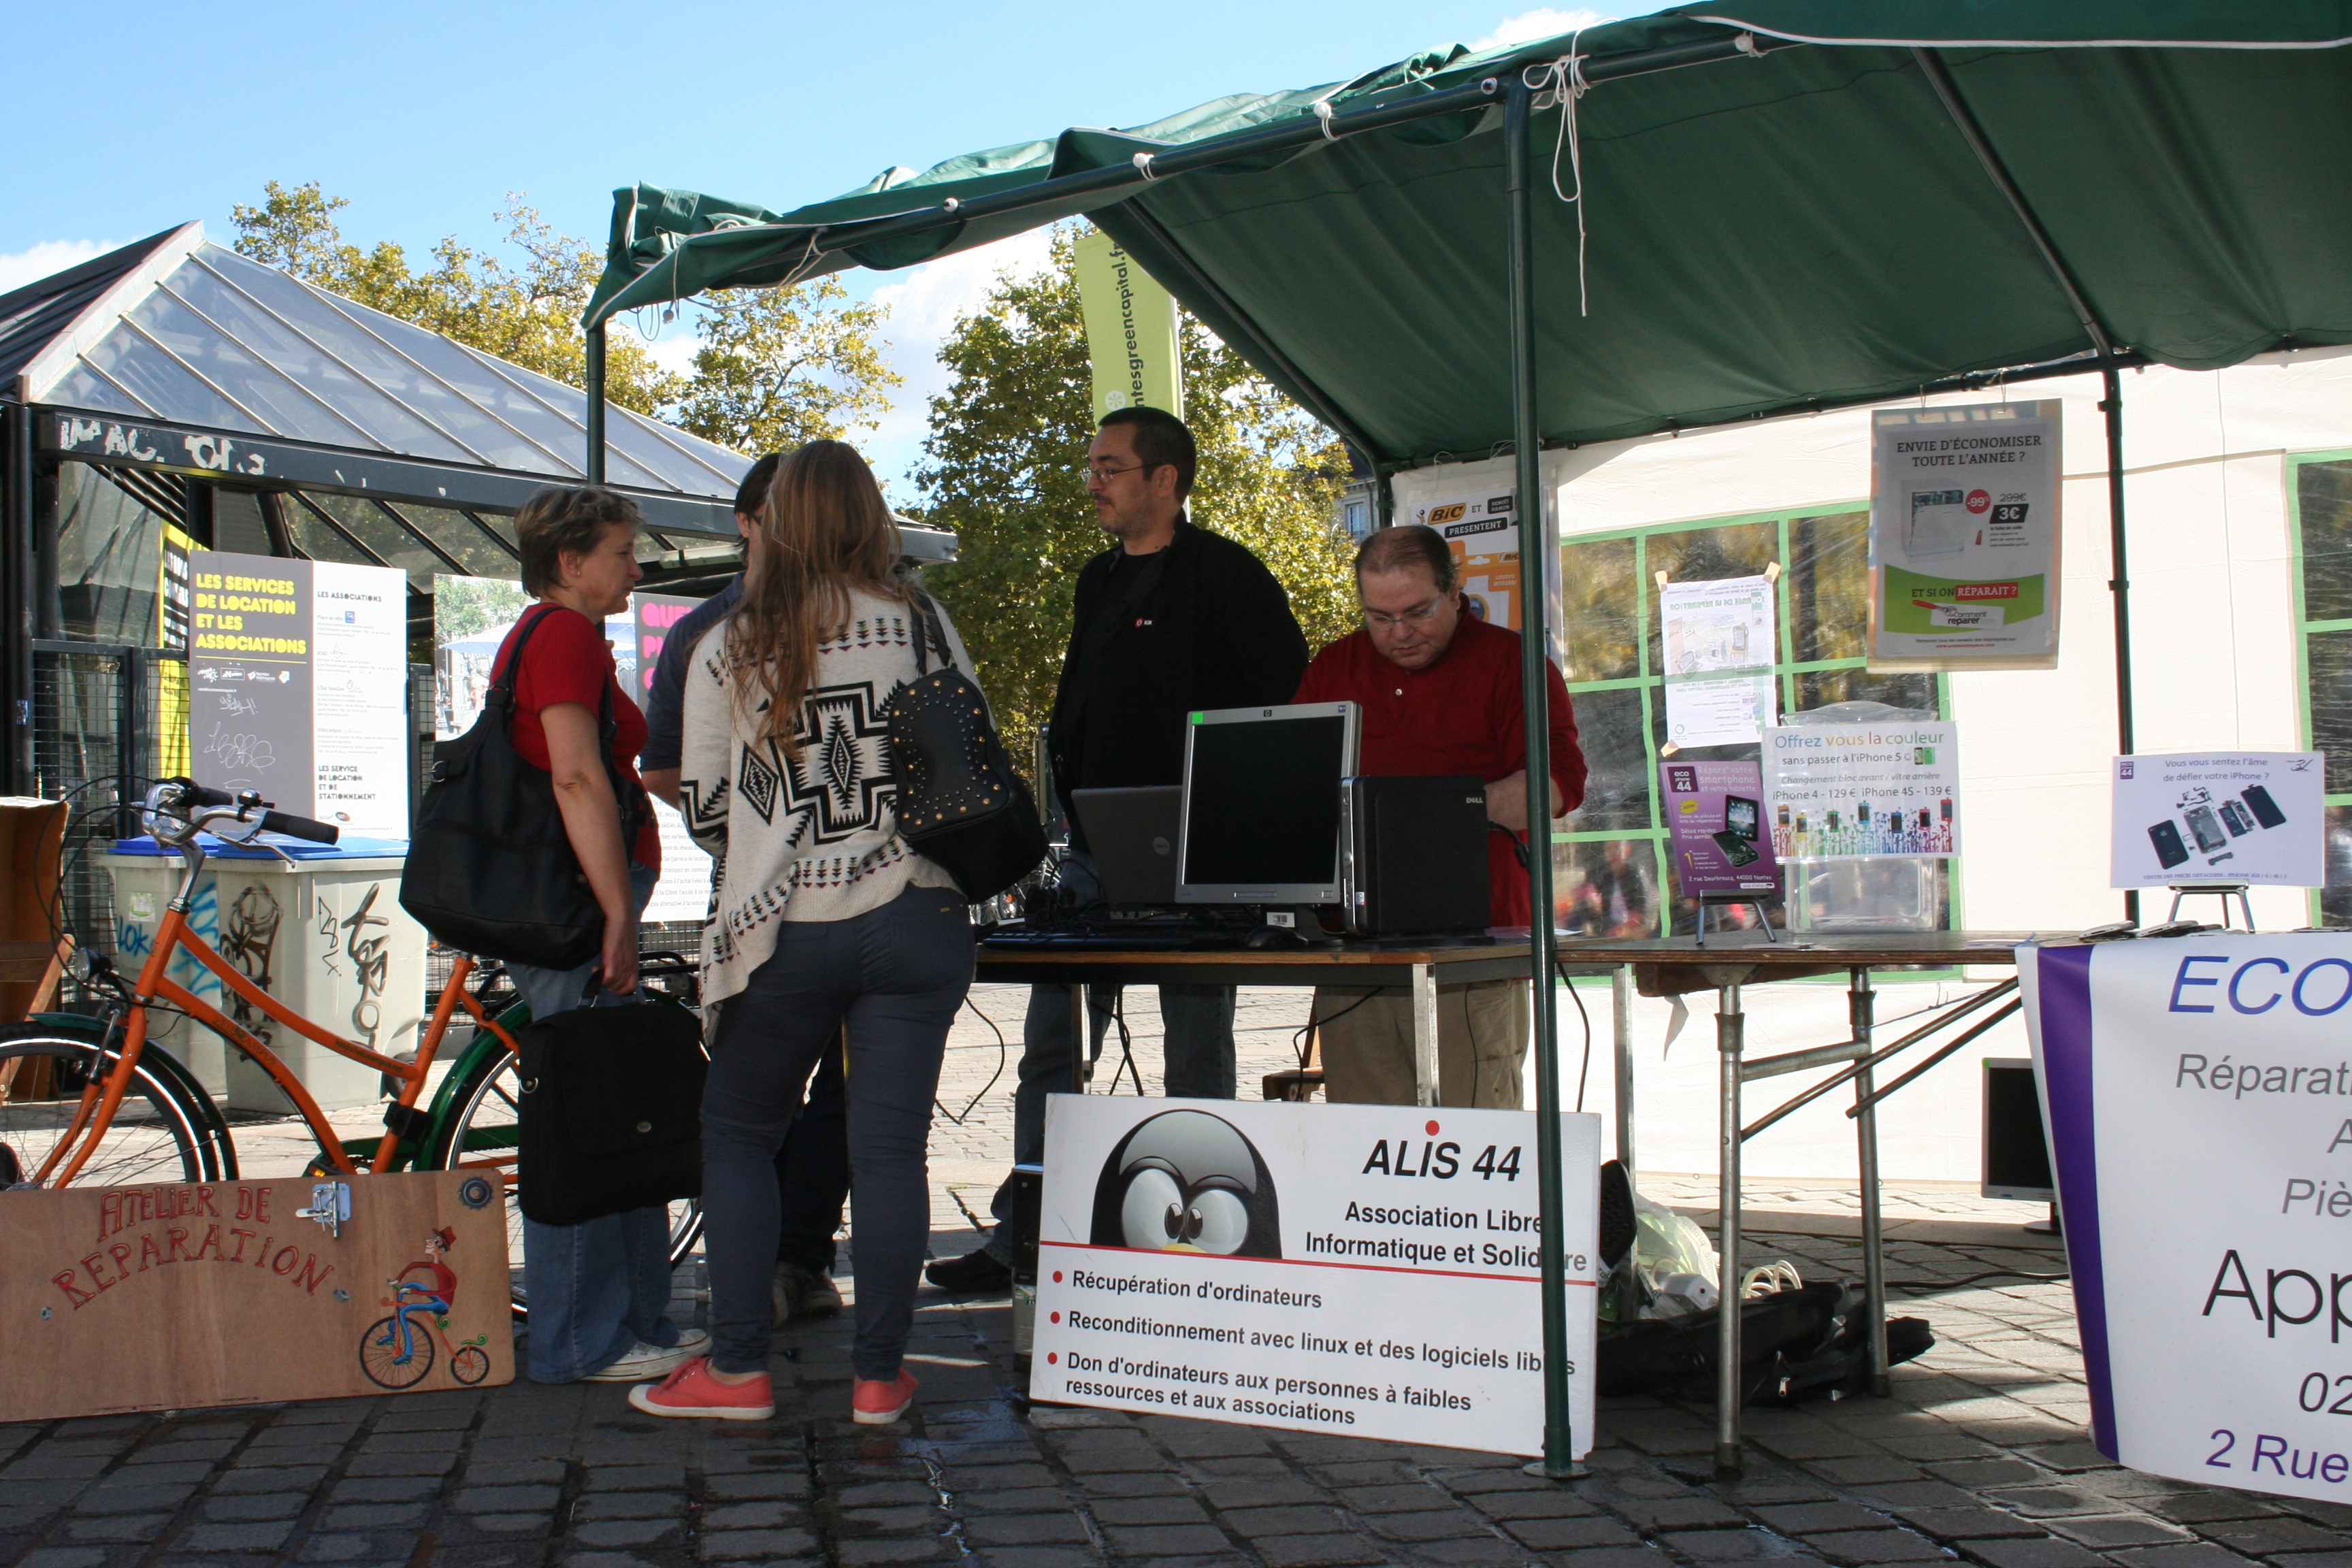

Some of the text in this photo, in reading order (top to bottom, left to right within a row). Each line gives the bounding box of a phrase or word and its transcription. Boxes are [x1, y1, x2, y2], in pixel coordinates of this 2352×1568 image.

[1897, 436, 2042, 453] ENVIE D'ÉCONOMISER
[1912, 451, 2025, 467] TOUTE L'ANNÉE ?
[1471, 504, 1482, 513] ET
[1998, 506, 2020, 520] 3€
[1449, 521, 1501, 536] PRESENTENT
[196, 573, 295, 595] LES SERVICES
[1912, 586, 2017, 598] ET SI ON RÉPARAIT ?
[196, 593, 296, 615] DE LOCATION
[331, 592, 382, 602] ASSOCIATIONS
[196, 613, 243, 631] ET LES
[642, 602, 692, 628] QUE
[195, 633, 306, 655] ASSOCIATIONS
[1775, 730, 1944, 749] Offrez vous la couleur
[1782, 753, 1901, 766] sans passer à l'iPhone 5
[1699, 774, 1754, 785] smartphone
[1781, 776, 1836, 785] Changement
[1838, 772, 1857, 782] bloc
[1891, 772, 1910, 781] vitre
[1912, 772, 1940, 781] arrière
[2120, 768, 2133, 777] 44
[2176, 773, 2202, 781] défier
[2230, 772, 2260, 780] iPhone
[1677, 781, 1691, 791] 44
[1772, 786, 1952, 800] iPhone 4 129 € iPhone 4S 139 €
[1472, 1145, 1522, 1181] 44
[235, 1186, 272, 1224] DE
[1345, 1201, 1542, 1234] Association Libre
[1306, 1232, 1587, 1271] Informatique et Solidre
[1073, 1271, 1322, 1309] Récupération d'ordinateurs
[1068, 1310, 1576, 1375] Reconditionnement avec linux et des logiciels libs
[1068, 1352, 1472, 1411] Don d'ordinateurs aux personnes à faibles
[1066, 1379, 1356, 1424] ressources et aux associations
[2205, 1428, 2349, 1484] 2 Rue
